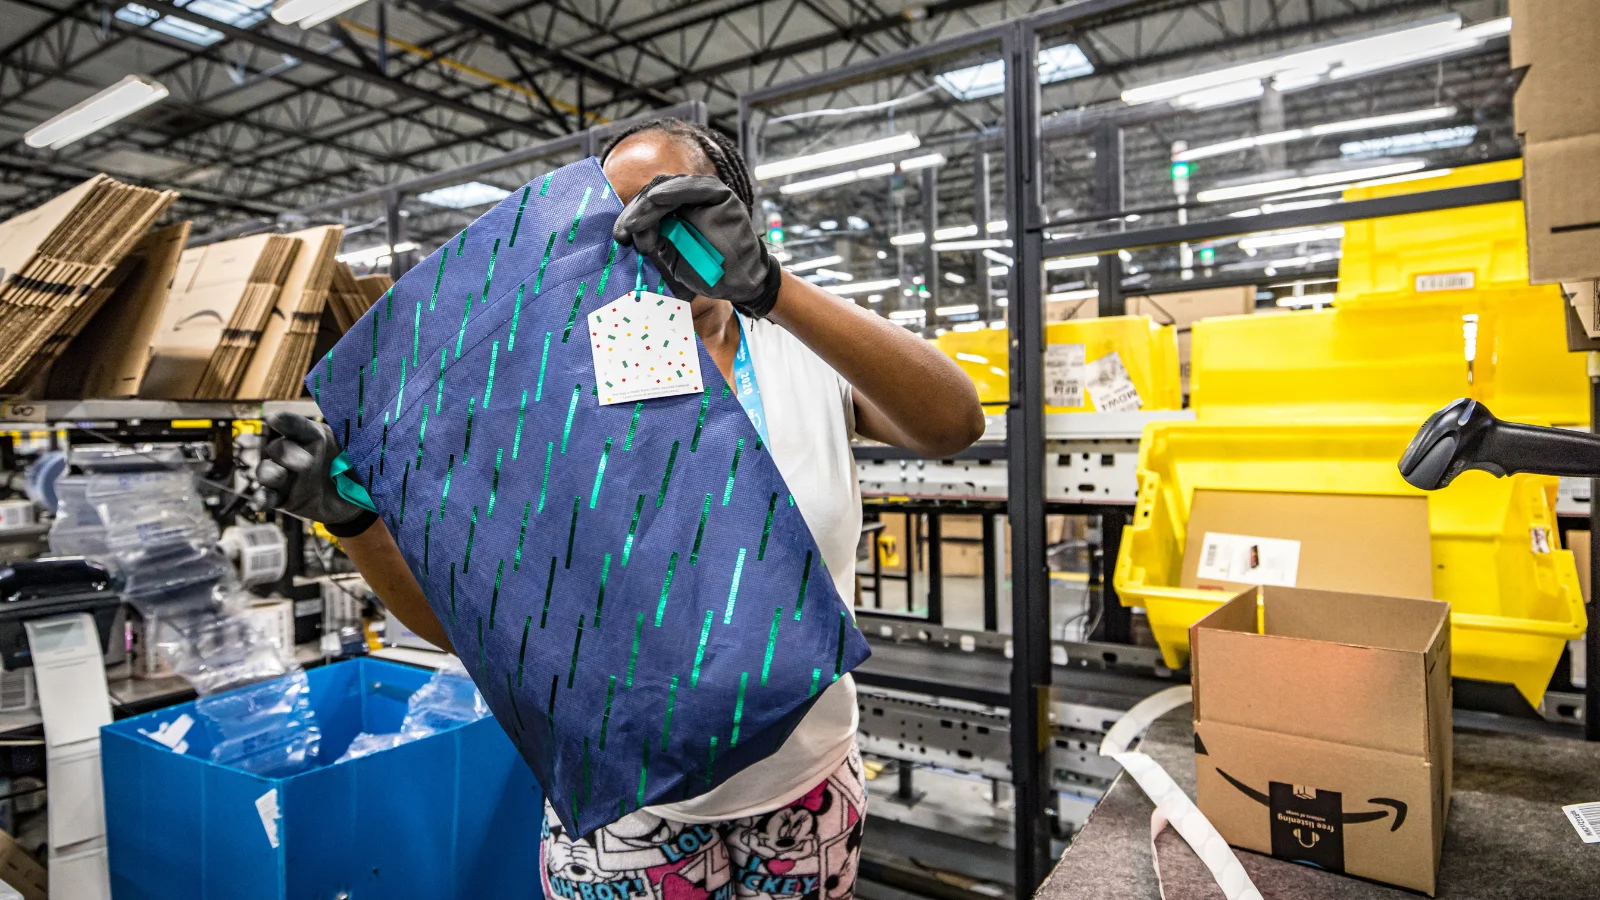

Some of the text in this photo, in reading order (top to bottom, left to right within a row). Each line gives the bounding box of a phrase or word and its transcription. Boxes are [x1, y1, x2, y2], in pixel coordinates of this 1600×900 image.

[741, 371, 753, 396] 2020
[1277, 813, 1335, 833] free listening
[661, 824, 713, 863] LOL
[550, 876, 648, 900] OH BOY!
